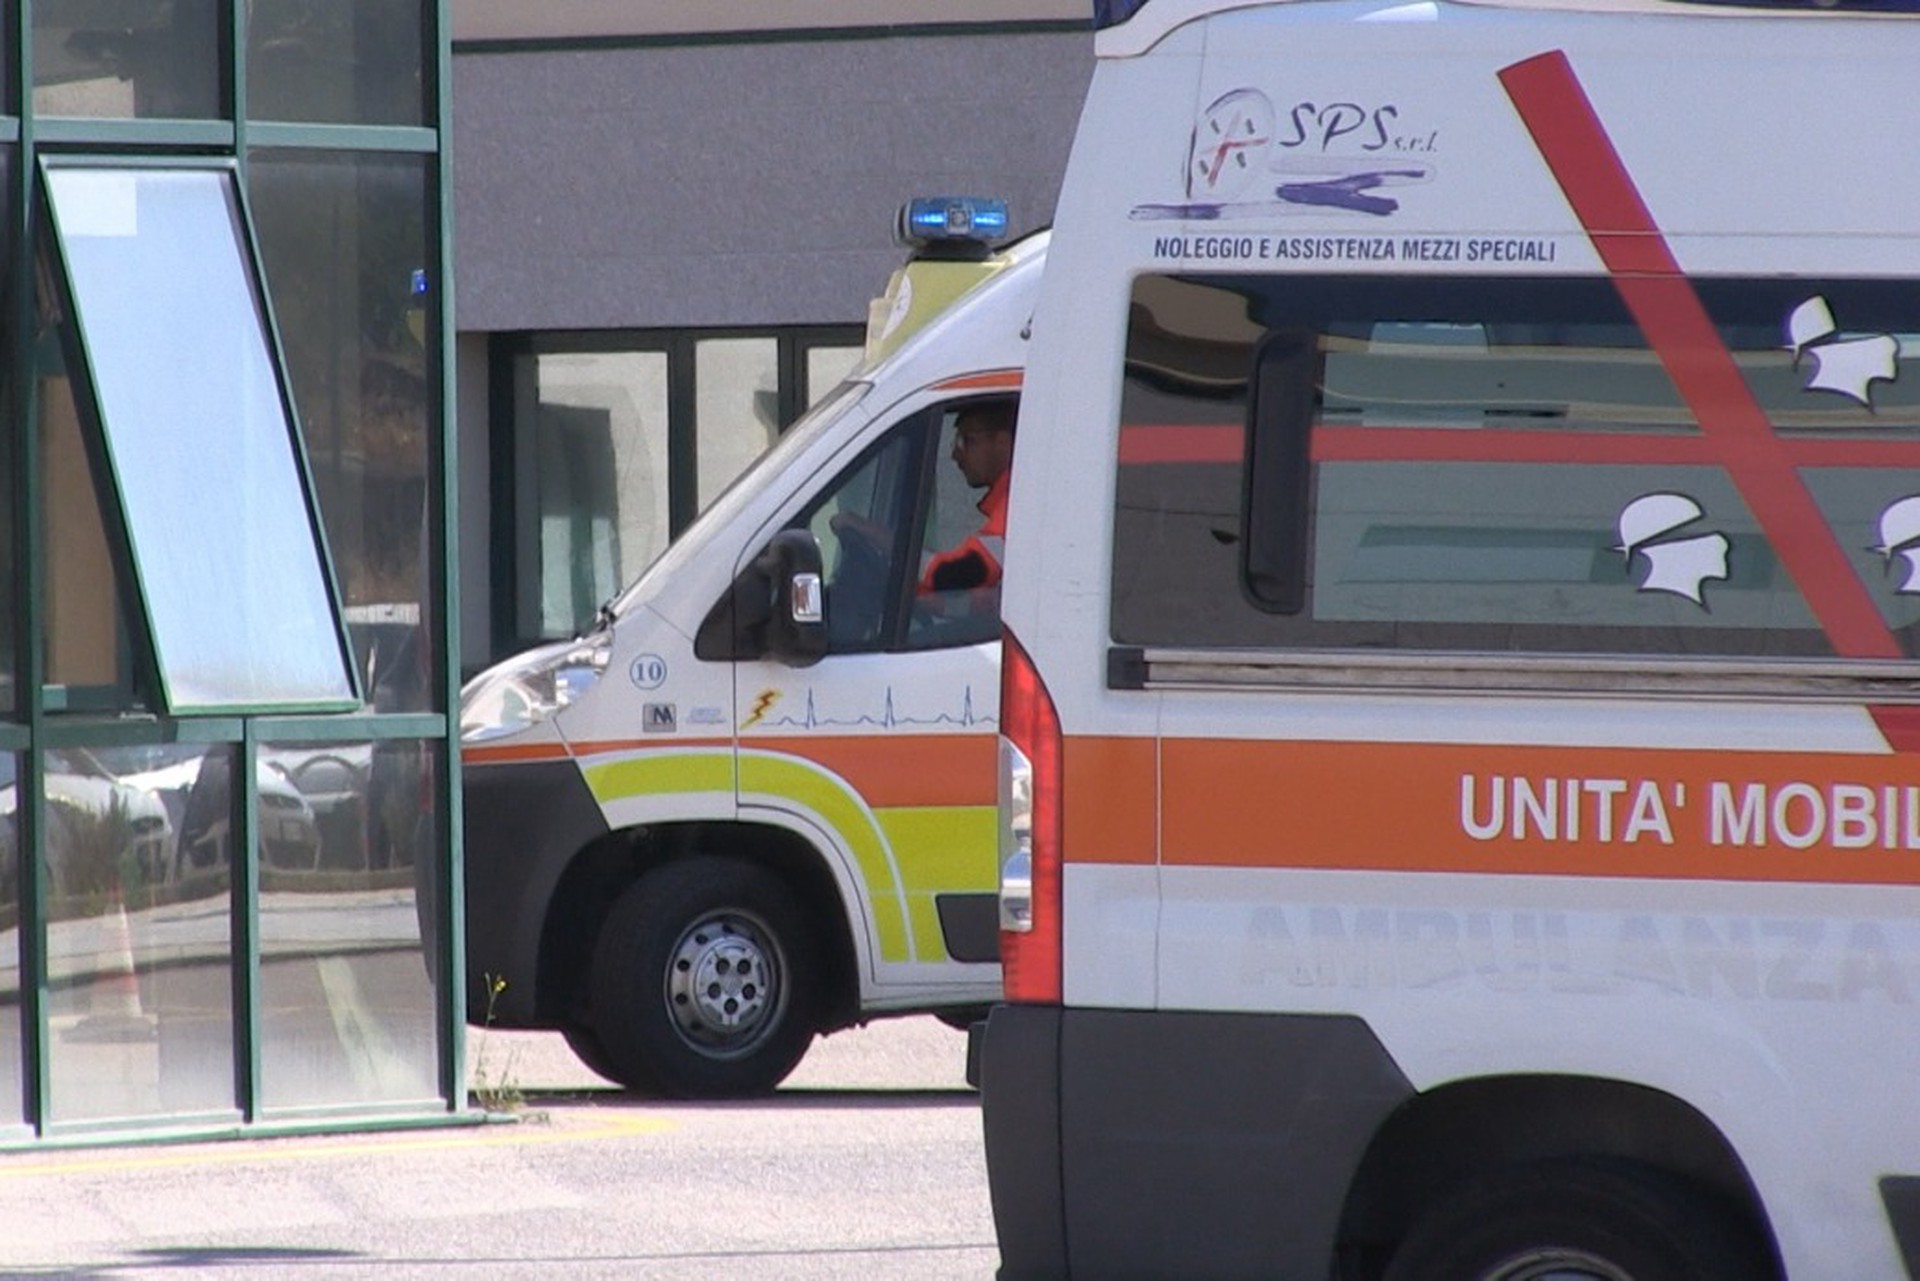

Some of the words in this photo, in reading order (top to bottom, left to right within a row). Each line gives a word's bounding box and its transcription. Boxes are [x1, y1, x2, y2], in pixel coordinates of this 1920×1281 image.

[1154, 237, 1253, 259] NOLEGGIO
[1259, 238, 1271, 259] E
[1276, 238, 1396, 260] ASSISTENZA
[1402, 240, 1460, 261] MEZZI
[1467, 240, 1556, 263] SPECIALI
[637, 662, 662, 682] 10
[1460, 774, 1686, 844] UNITA'
[1709, 782, 1920, 850] MOBIL
